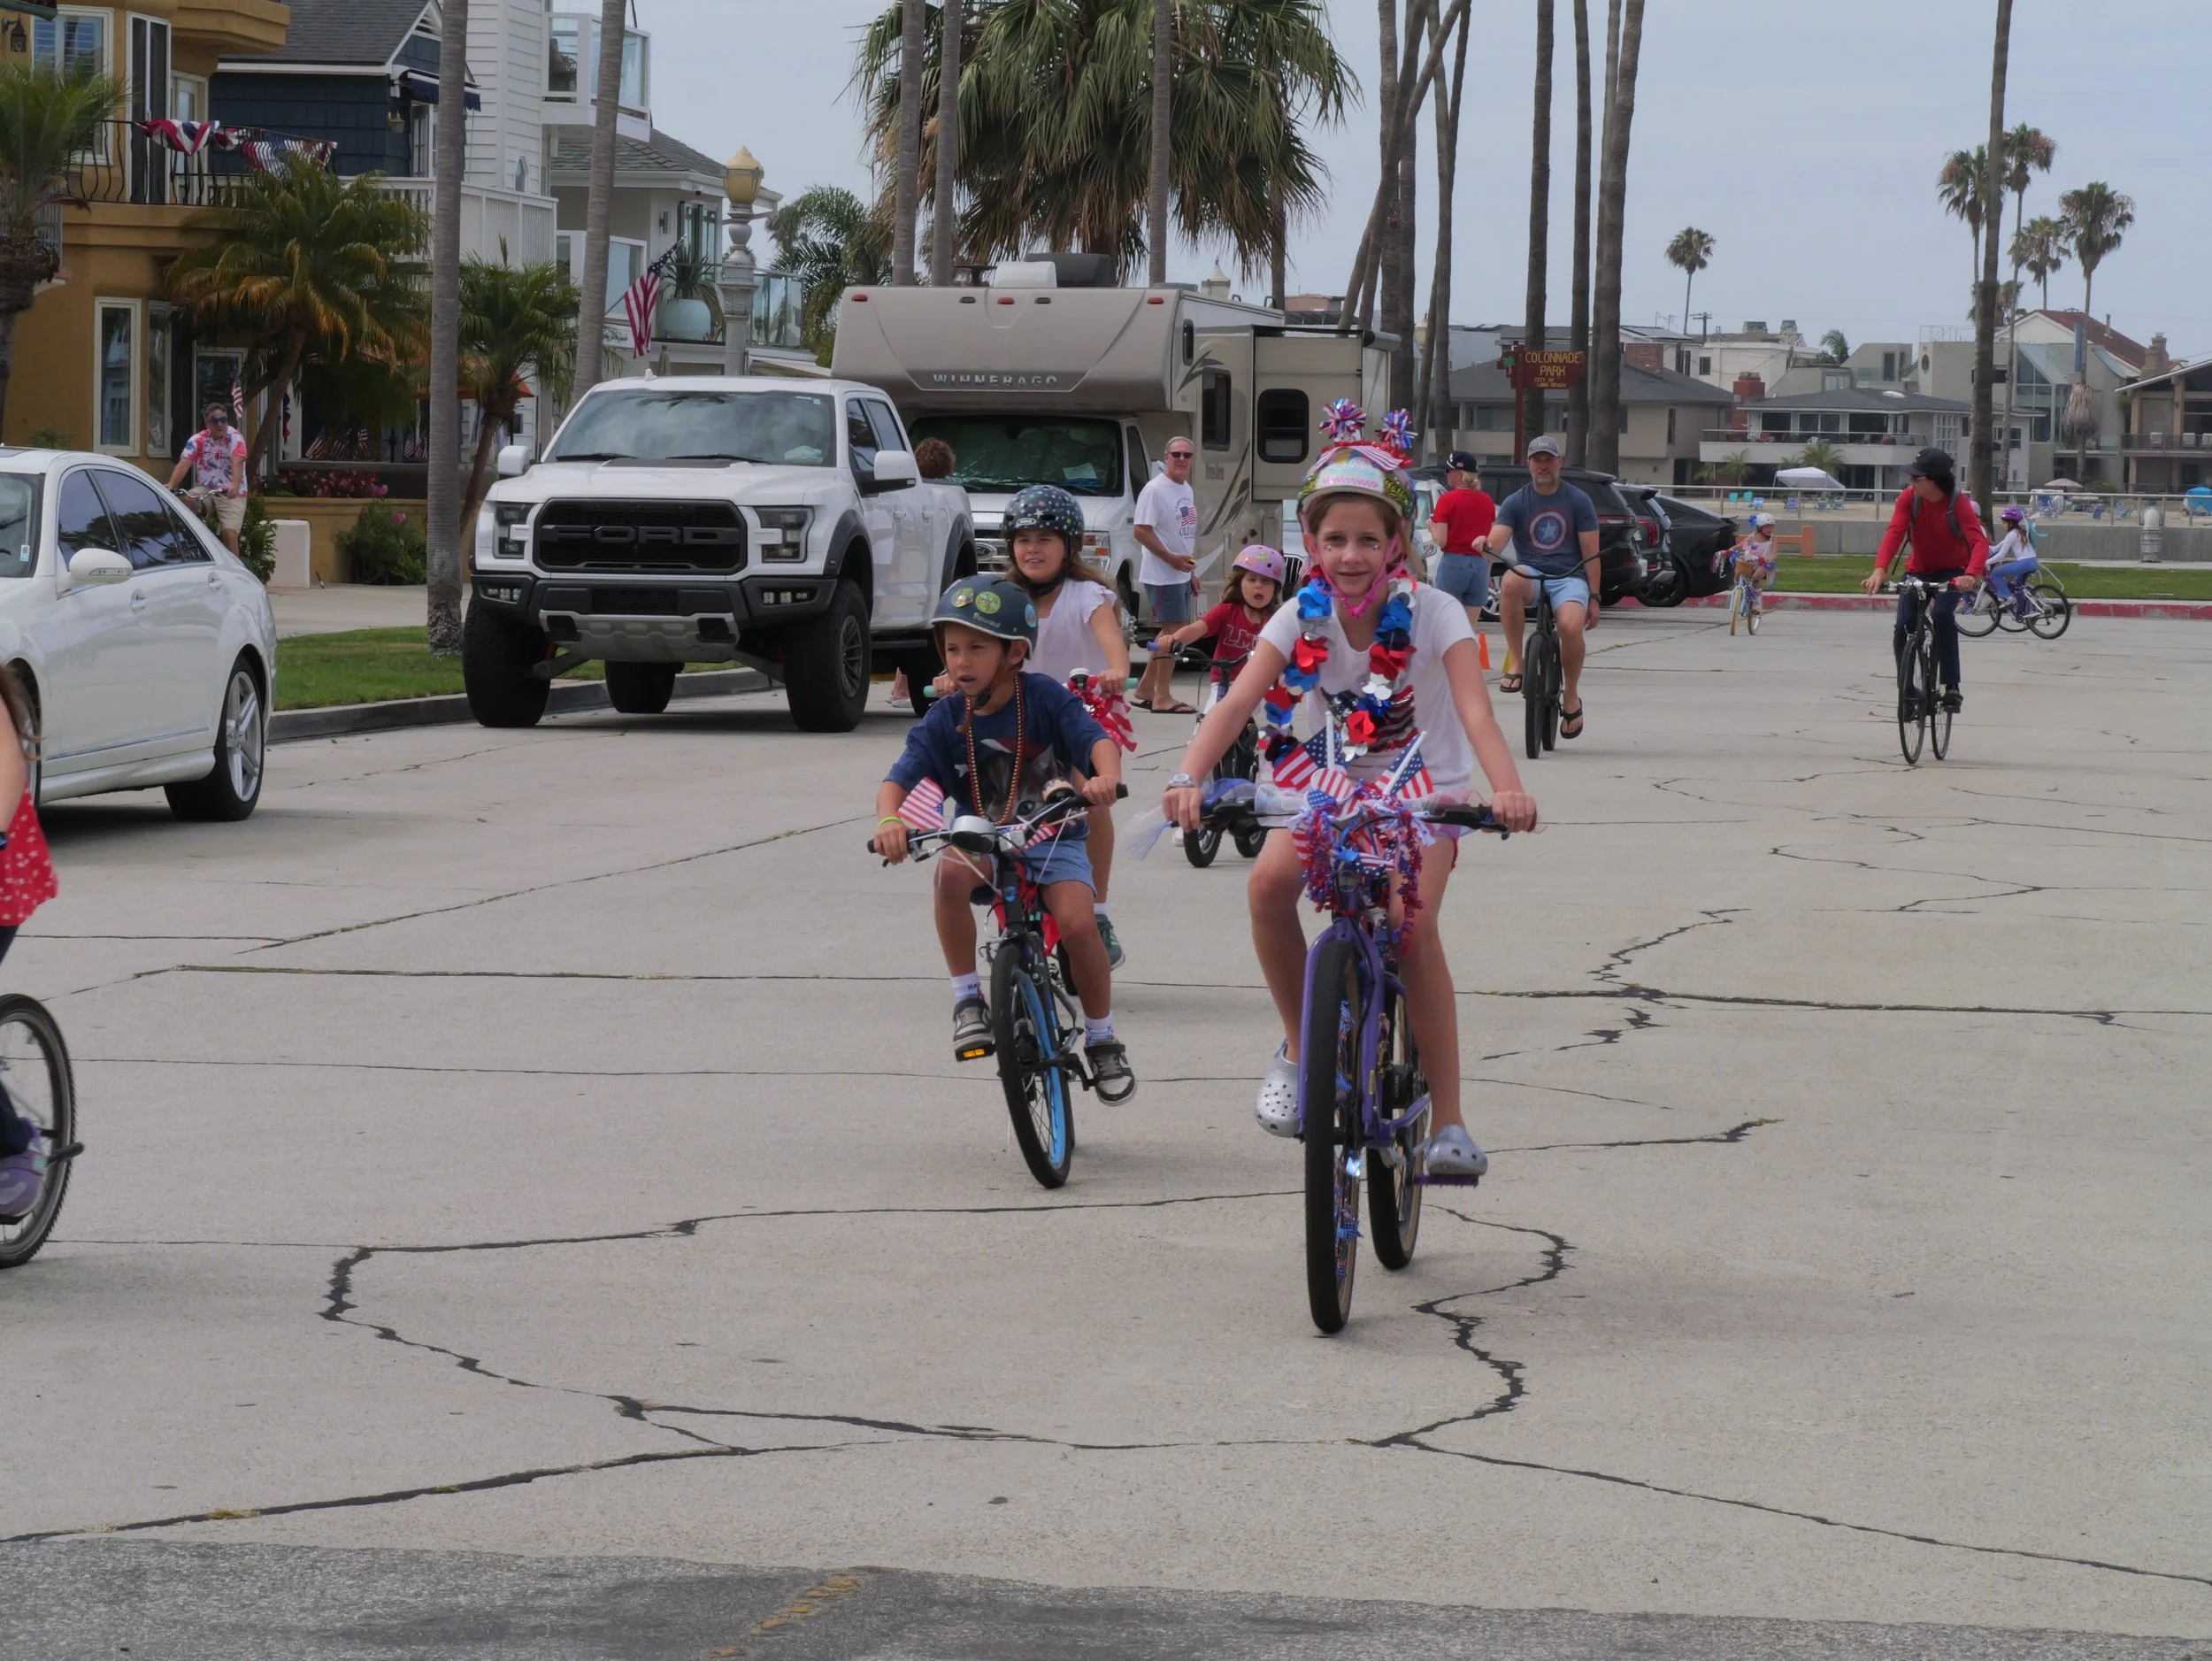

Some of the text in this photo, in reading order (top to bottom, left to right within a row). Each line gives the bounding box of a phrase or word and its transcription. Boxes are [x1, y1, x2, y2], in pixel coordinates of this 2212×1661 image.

[1525, 352, 1581, 364] COLONNADE
[1540, 365, 1566, 377] PARK
[932, 373, 1059, 388] WINNEBAGO
[541, 524, 741, 545] FORD
